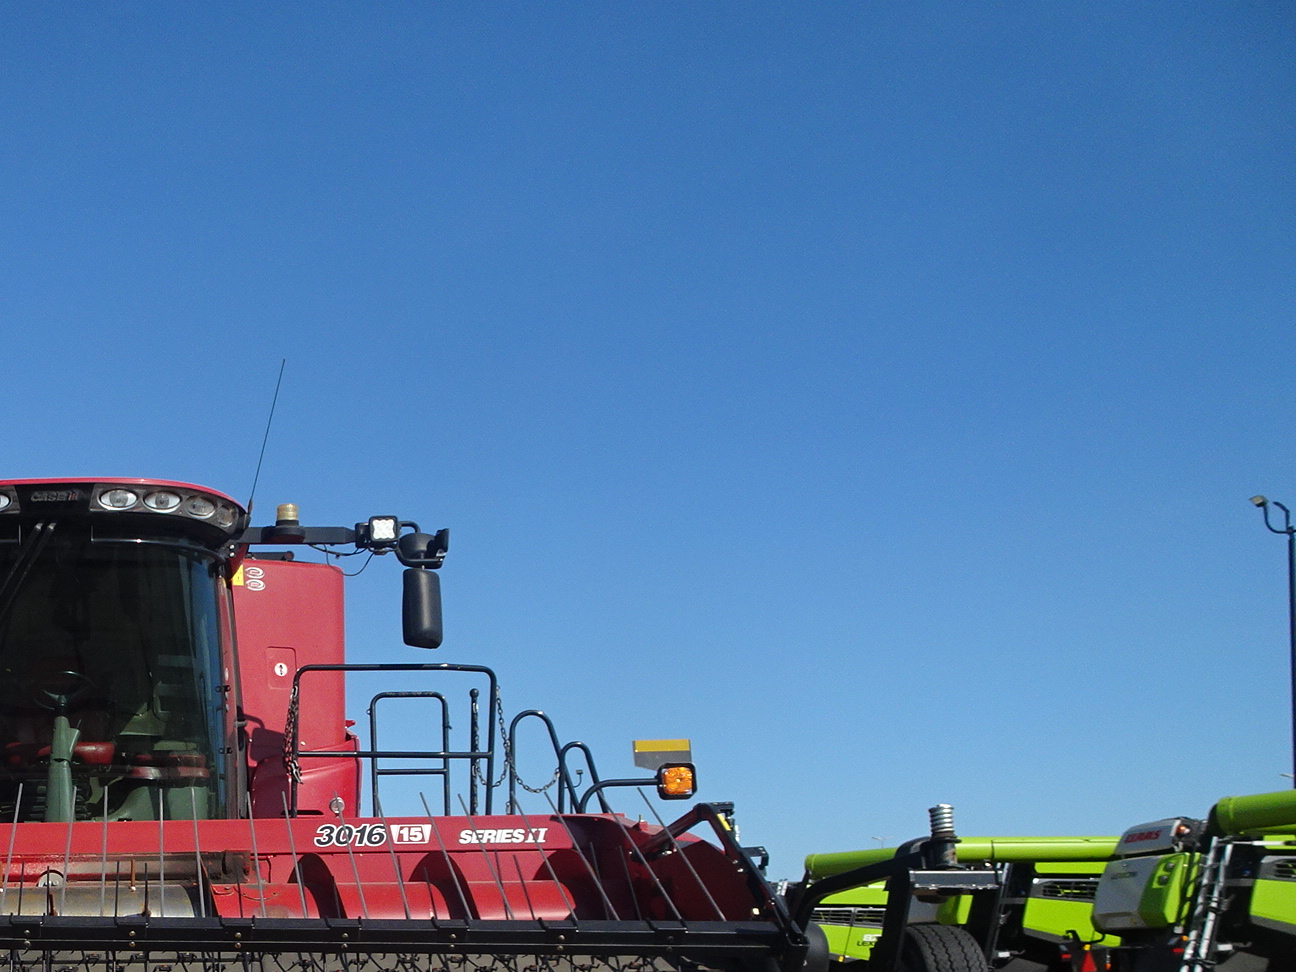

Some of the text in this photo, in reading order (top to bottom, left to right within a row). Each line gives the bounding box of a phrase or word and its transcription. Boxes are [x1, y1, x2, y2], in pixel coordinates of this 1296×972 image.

[314, 824, 423, 847] 3016 15
[458, 828, 526, 844] SERIES
